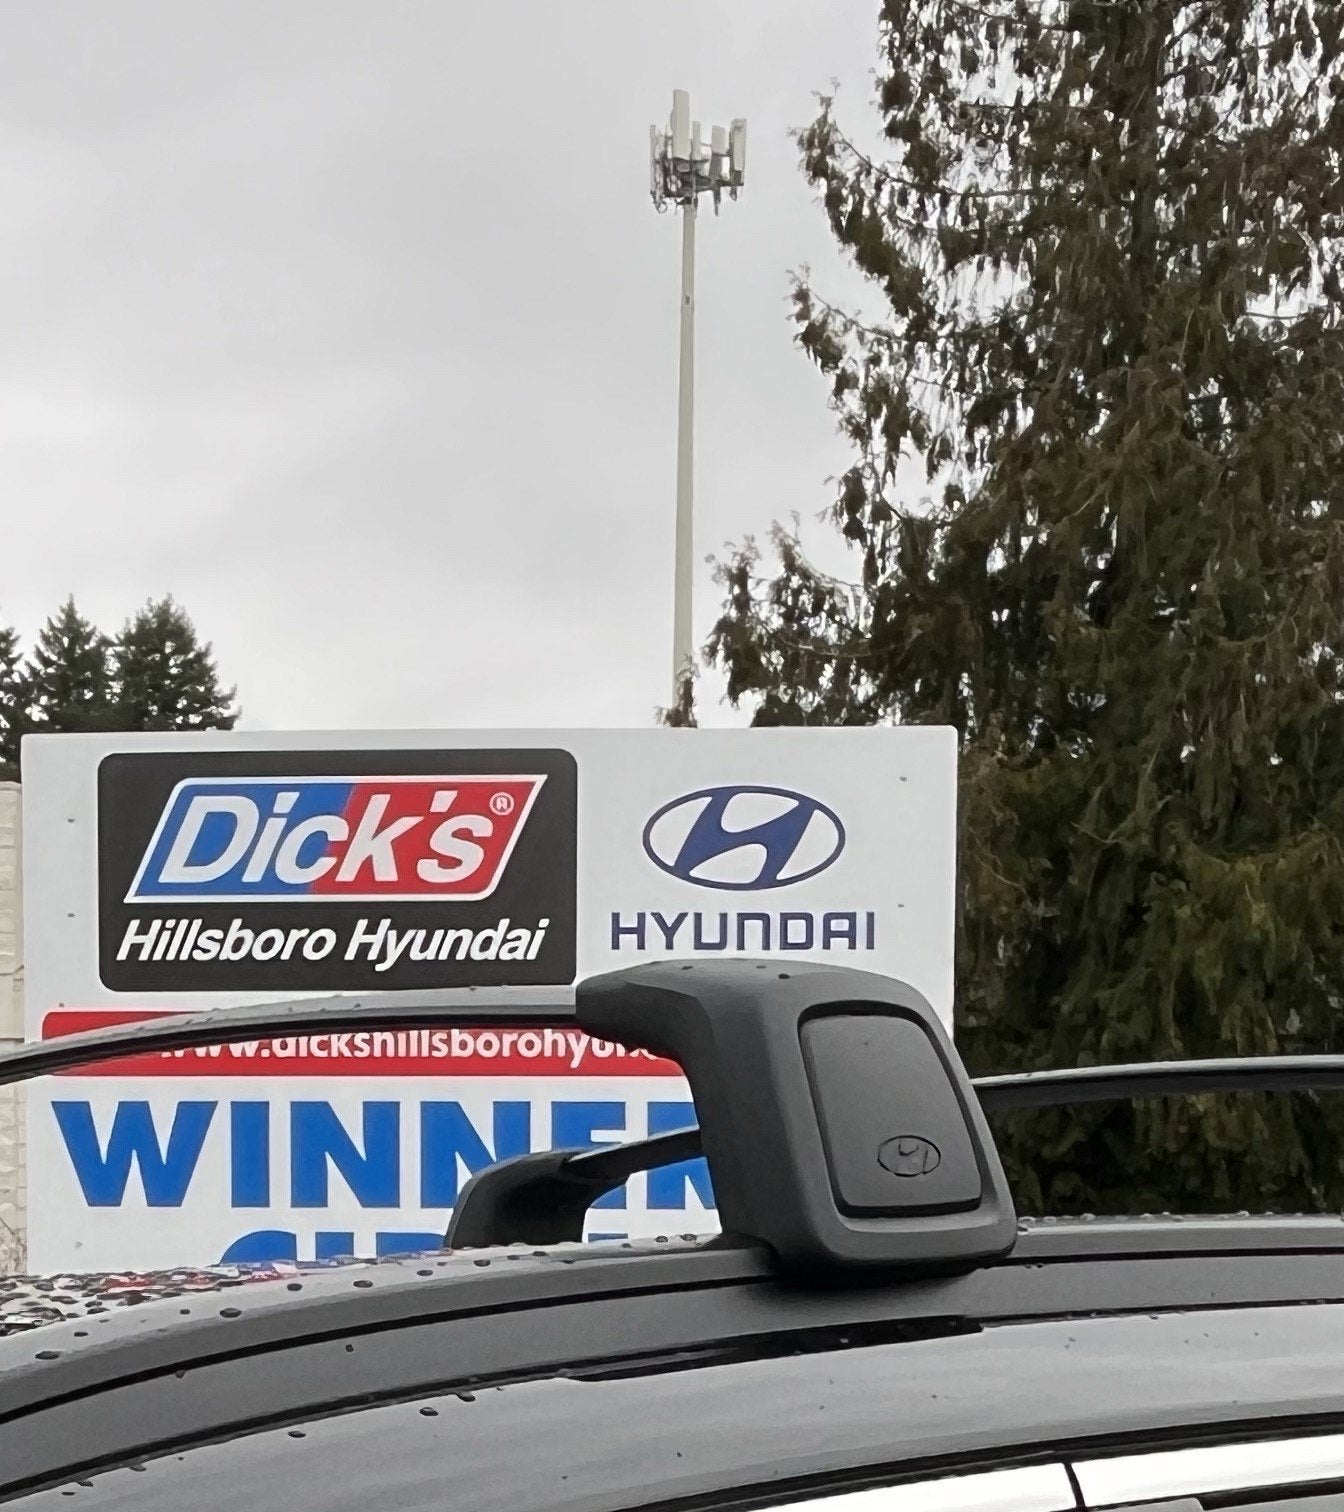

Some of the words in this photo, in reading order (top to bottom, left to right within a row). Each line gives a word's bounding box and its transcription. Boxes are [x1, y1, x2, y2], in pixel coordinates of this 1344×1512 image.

[115, 918, 336, 962] Hillsboro
[344, 918, 549, 972] Hyundai
[611, 911, 875, 951] HYUNDAI
